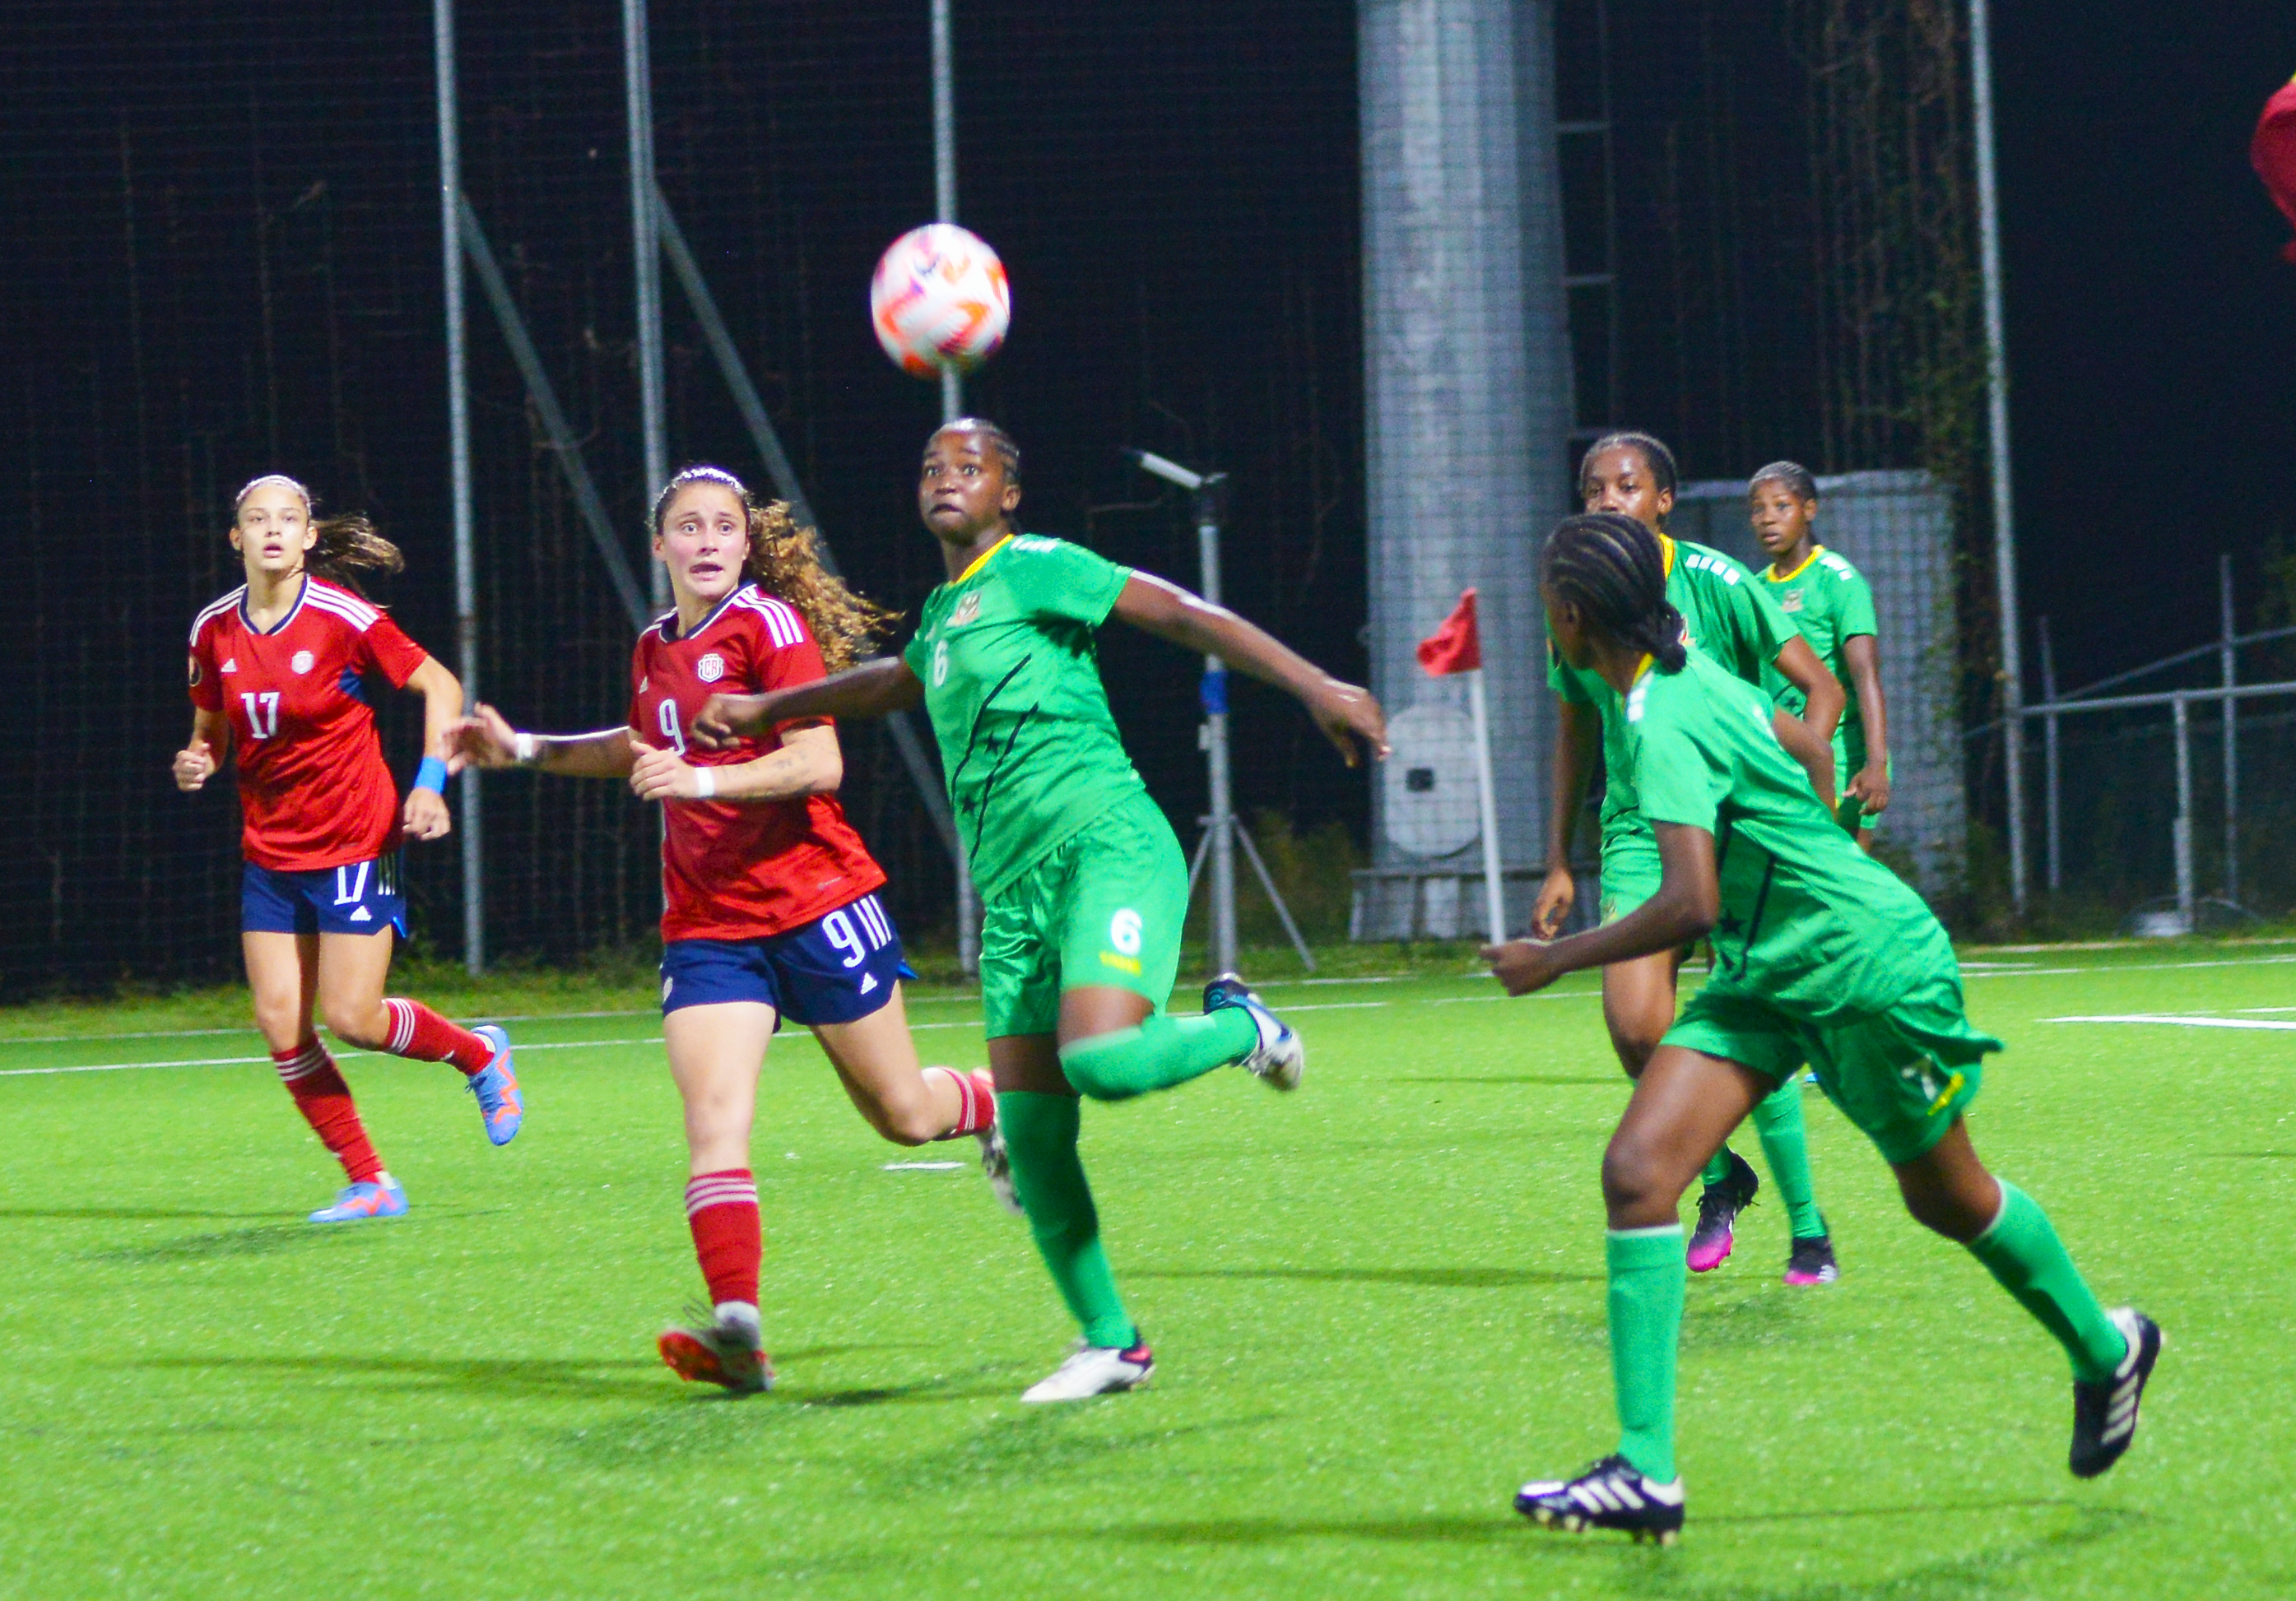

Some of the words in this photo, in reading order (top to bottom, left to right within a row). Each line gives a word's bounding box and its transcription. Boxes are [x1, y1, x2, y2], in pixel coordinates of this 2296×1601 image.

[934, 639, 949, 687] 6
[241, 691, 280, 739] 17
[659, 698, 686, 756] 9
[333, 861, 370, 905] 17
[822, 911, 866, 968] 9
[1111, 908, 1141, 957] 6
